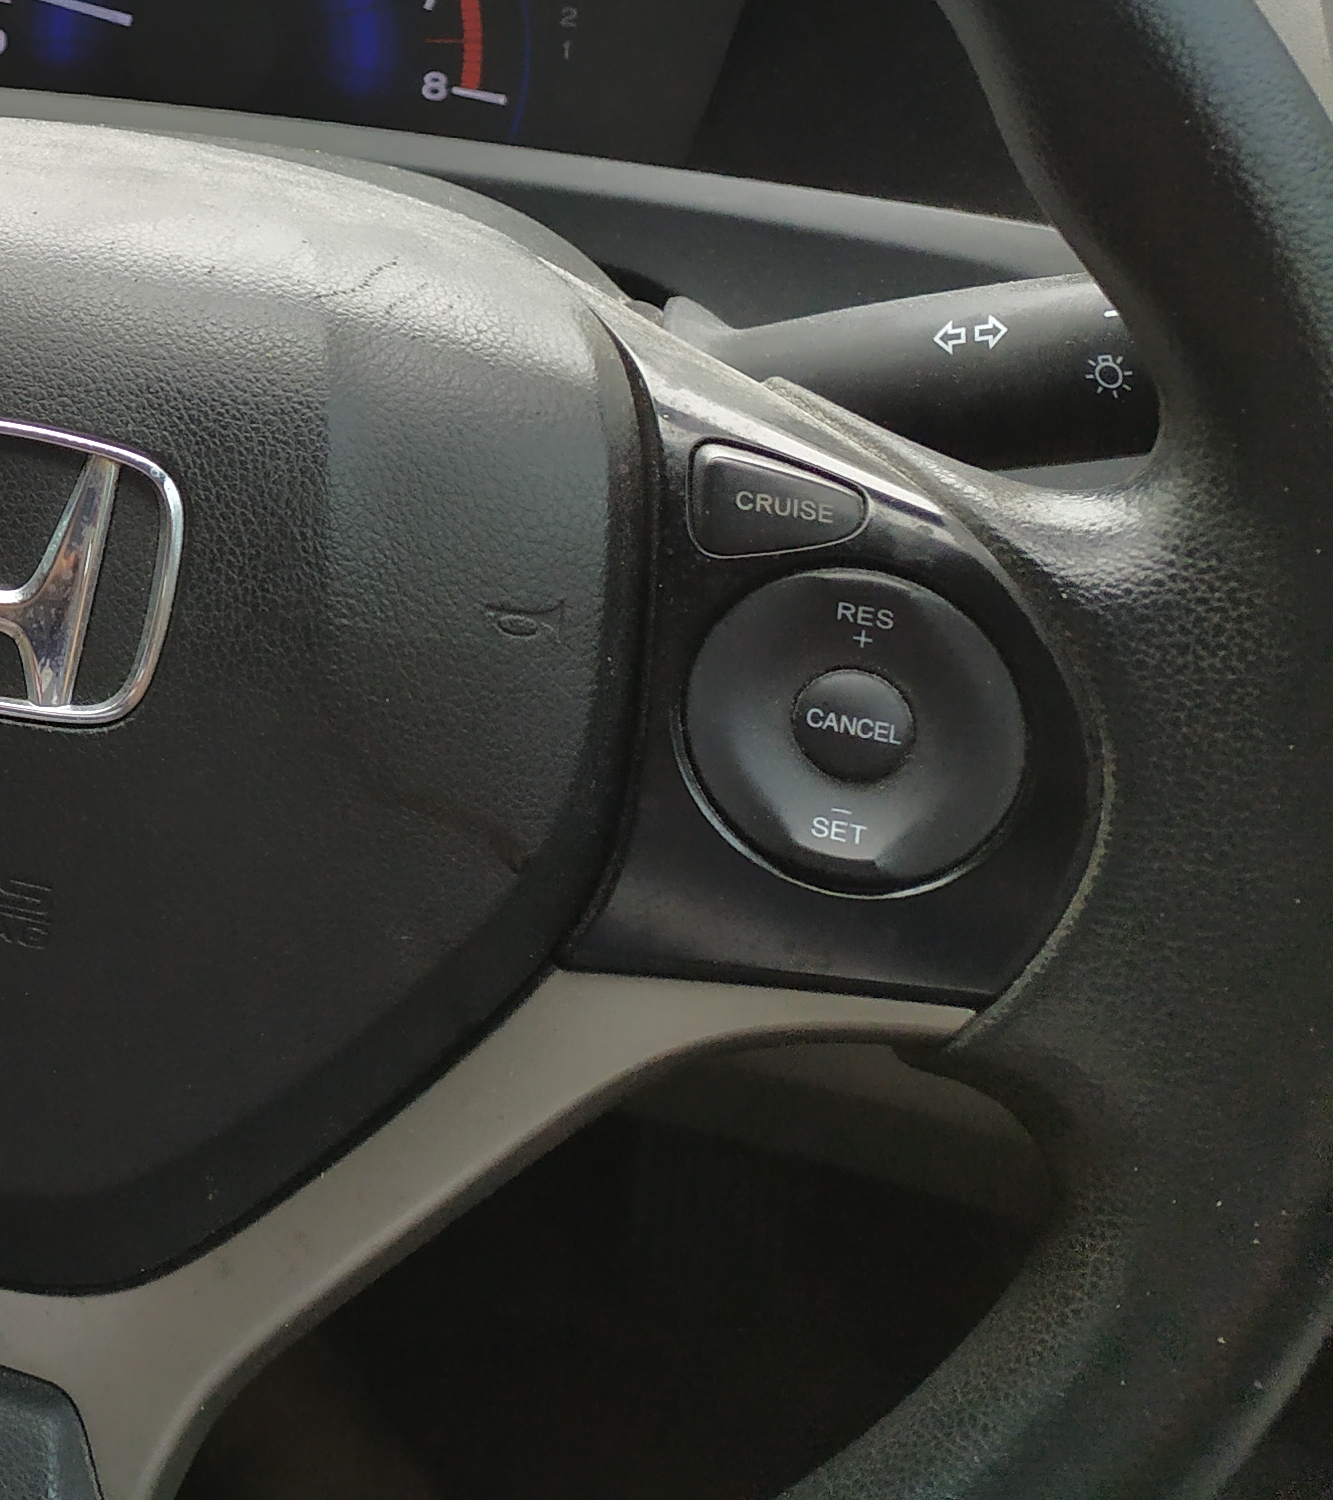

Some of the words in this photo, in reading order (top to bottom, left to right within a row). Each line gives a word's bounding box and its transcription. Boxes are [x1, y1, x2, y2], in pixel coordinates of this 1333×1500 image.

[421, 71, 448, 101] 8
[735, 490, 834, 525] CRUISE
[836, 601, 895, 630] RES
[806, 707, 902, 746] CANCEL
[811, 816, 868, 845] SET
